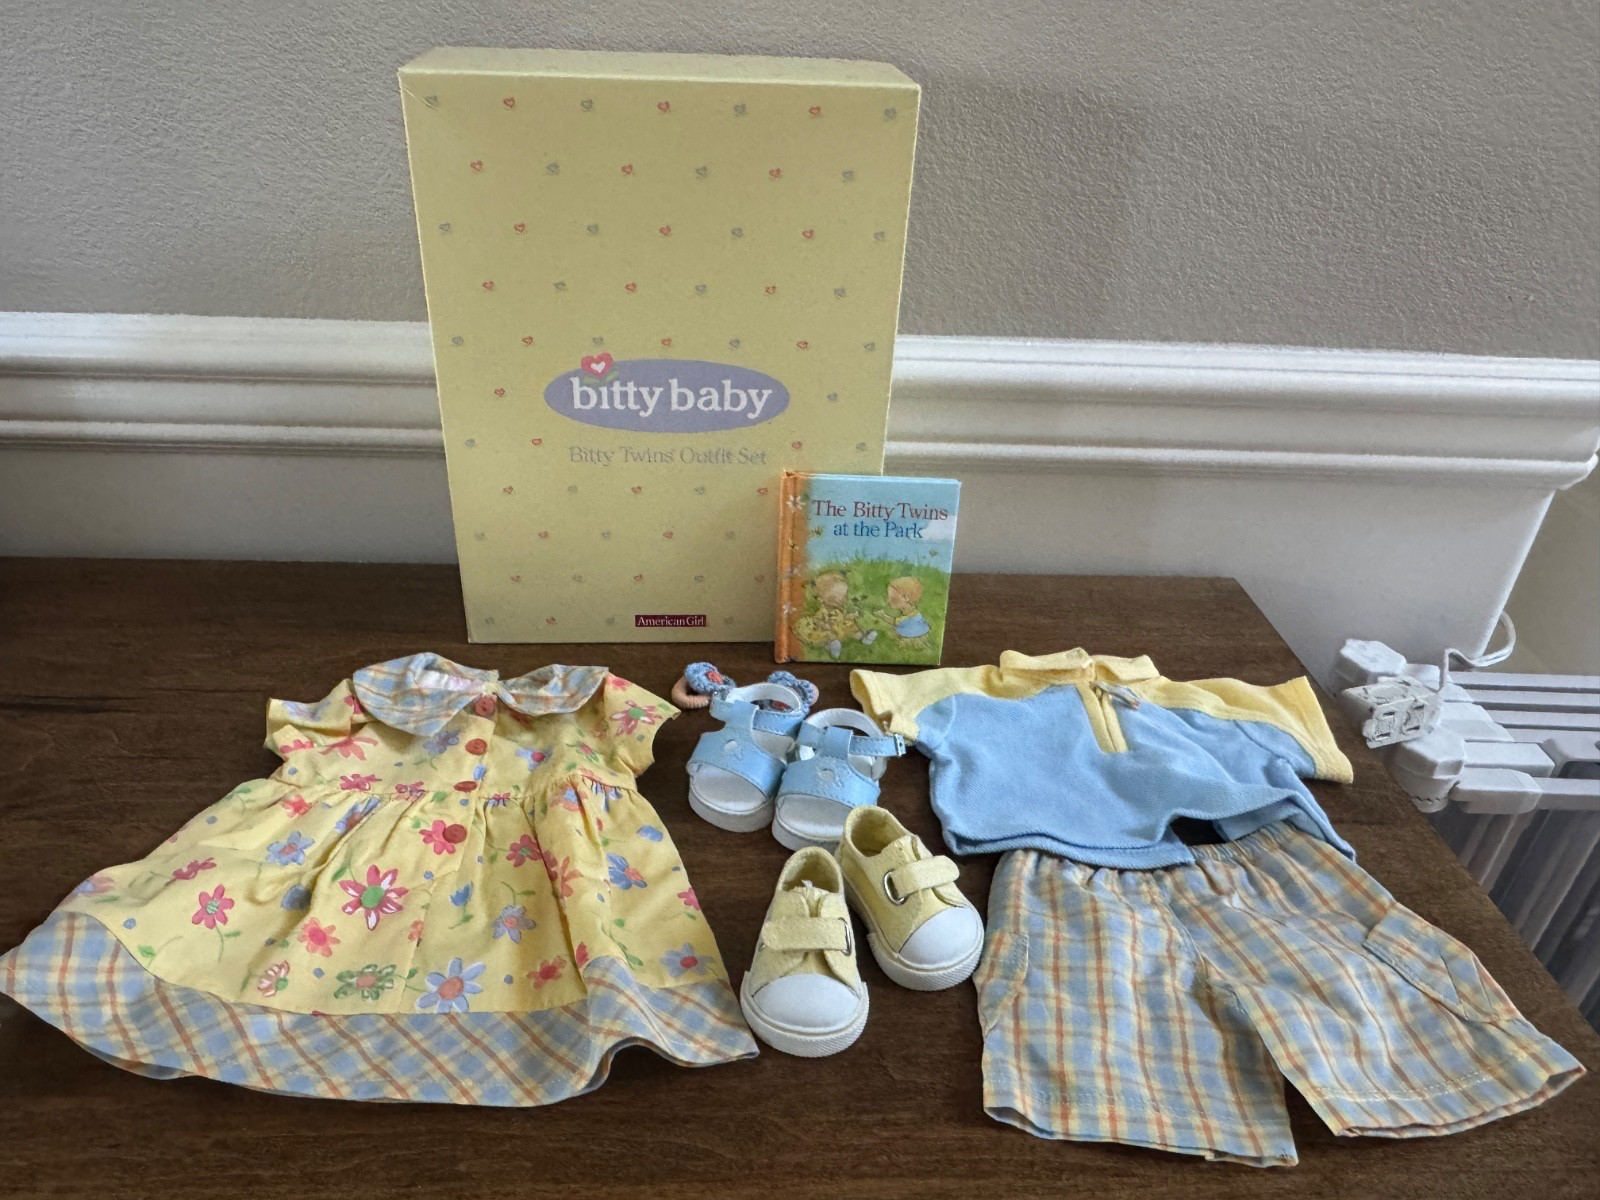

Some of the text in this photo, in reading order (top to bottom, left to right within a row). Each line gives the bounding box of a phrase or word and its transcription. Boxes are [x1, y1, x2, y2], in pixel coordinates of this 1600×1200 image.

[570, 377, 773, 419] bitty baby
[569, 446, 768, 467] Bitty Twins Outfit Set
[811, 499, 949, 521] The Bitty Twins
[833, 520, 924, 539] at the Park
[637, 615, 704, 626] American Girl
